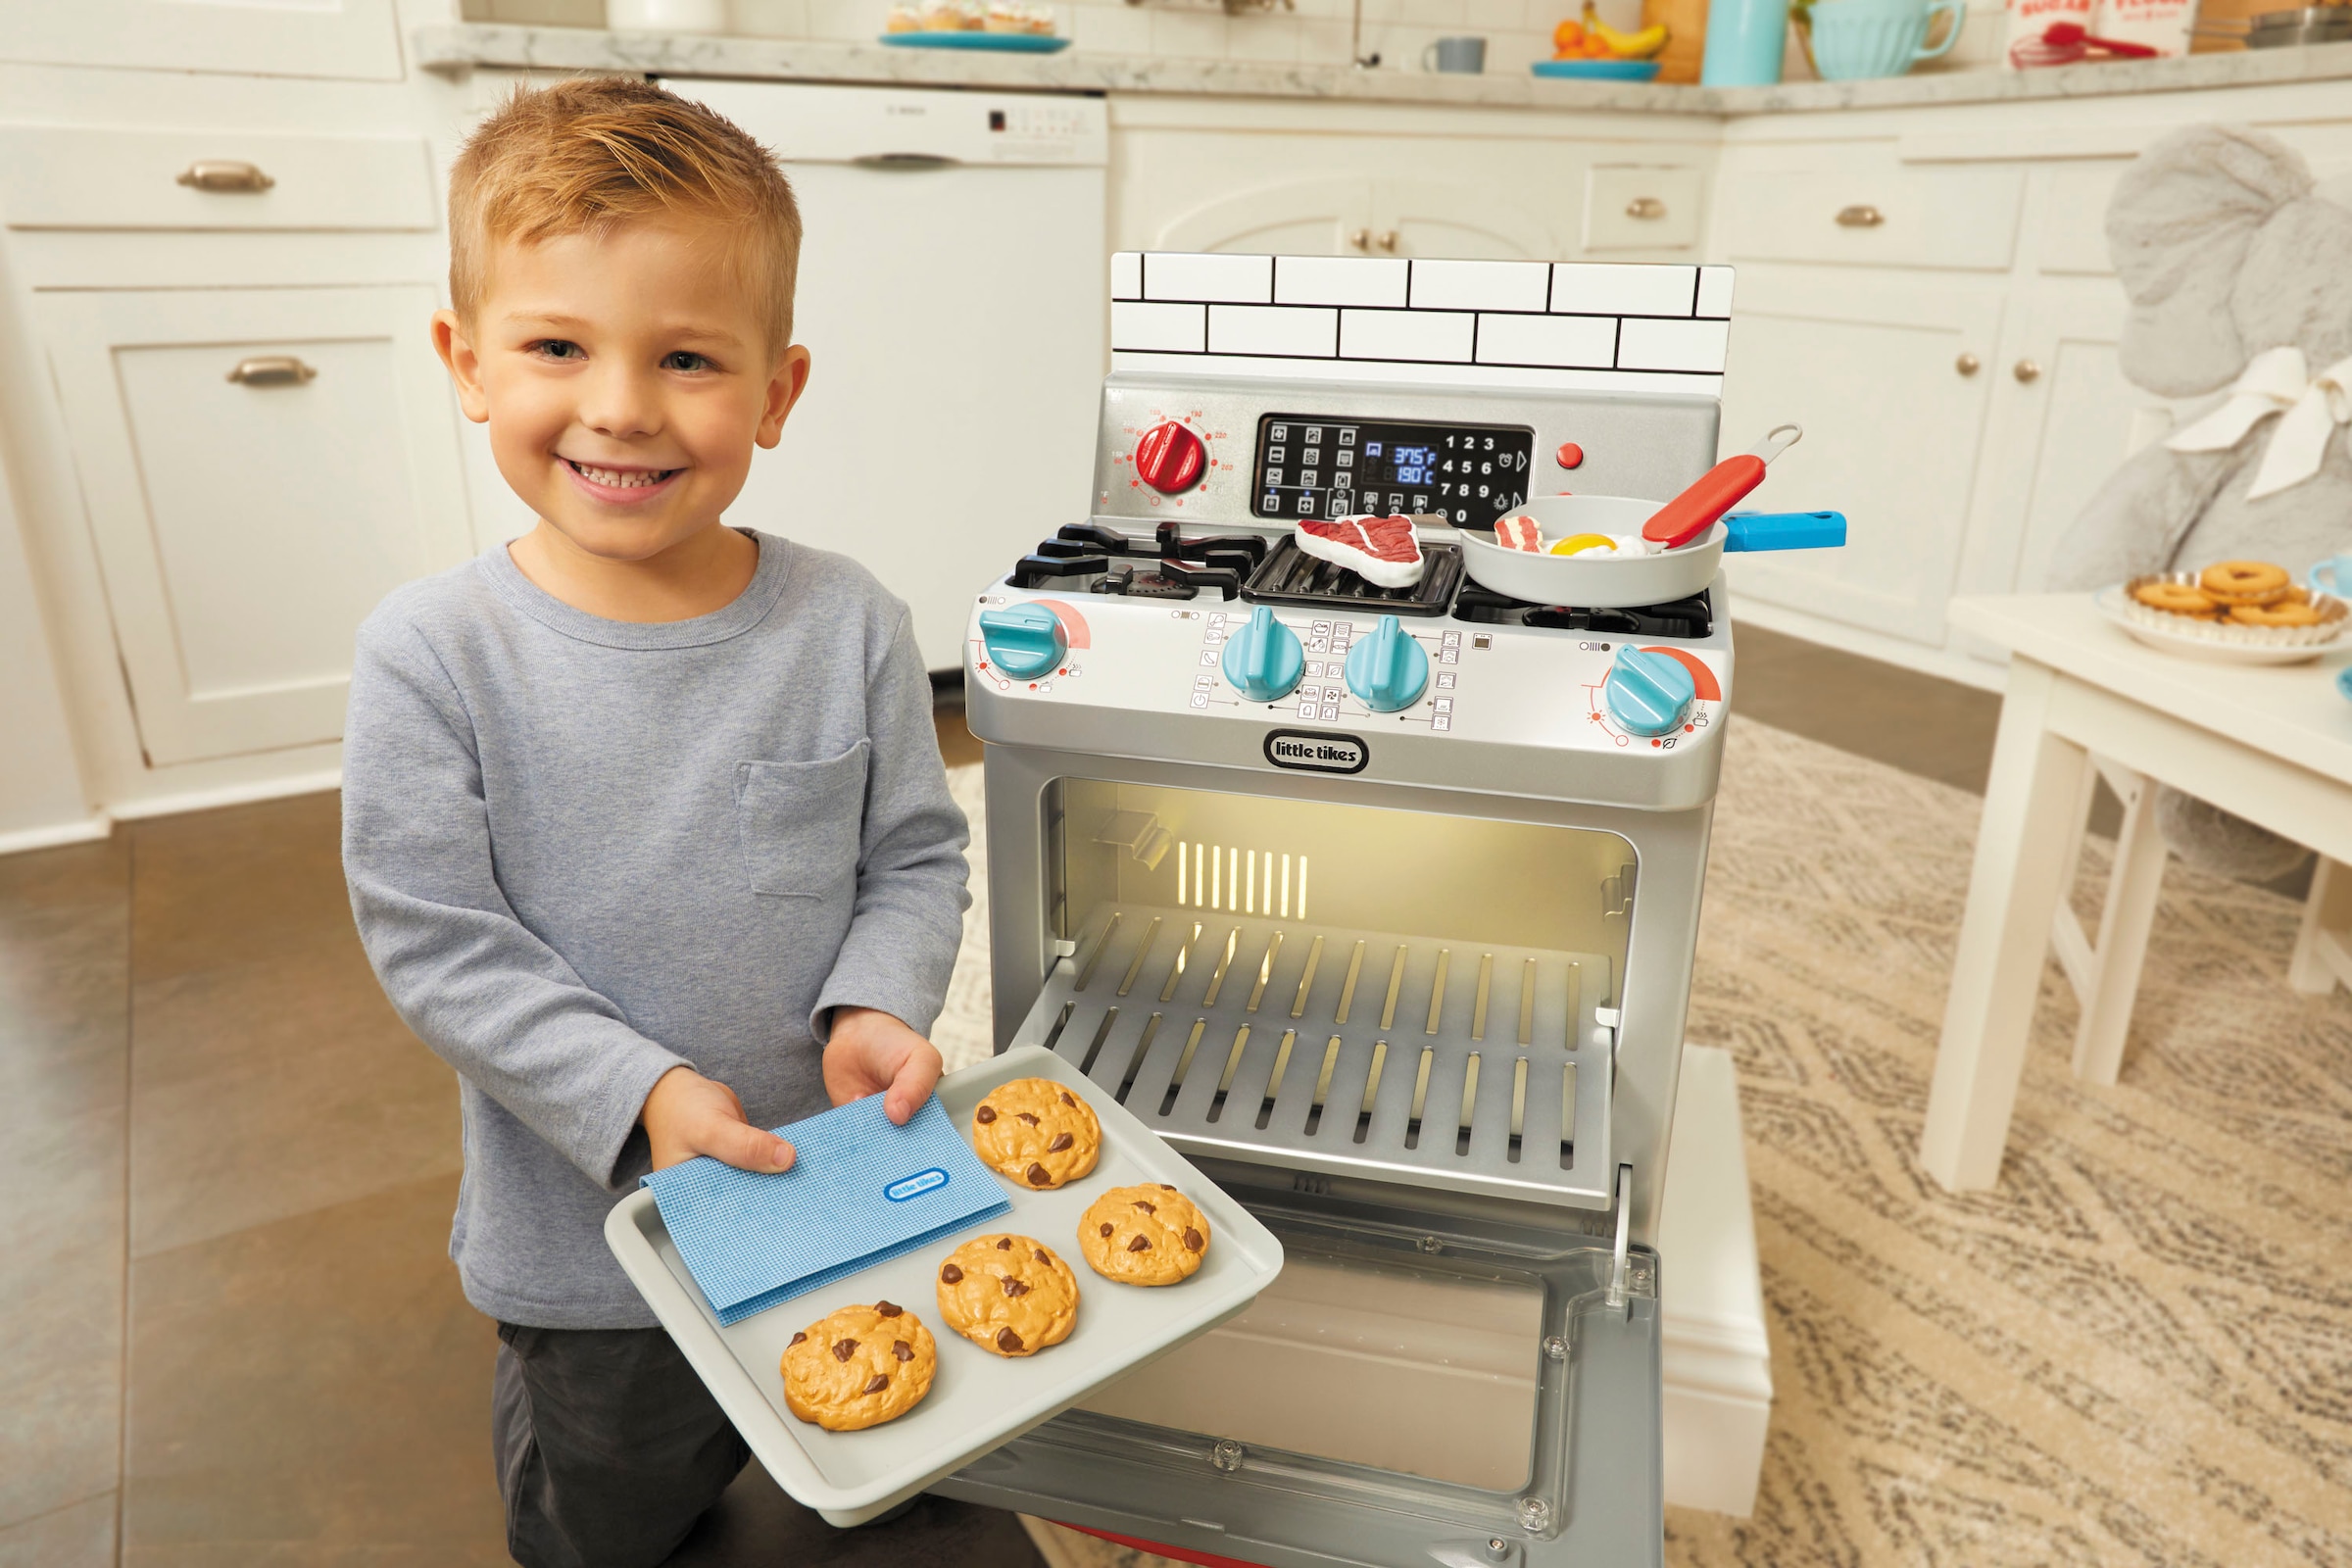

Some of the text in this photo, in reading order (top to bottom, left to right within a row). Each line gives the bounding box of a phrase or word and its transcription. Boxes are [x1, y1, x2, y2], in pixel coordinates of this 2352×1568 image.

[1446, 435, 1494, 451] 1 2 3
[1443, 460, 1493, 475] 4 5 6
[1441, 482, 1490, 498] 7 8 9
[1456, 510, 1467, 522] 0
[1276, 741, 1356, 761] little tikes
